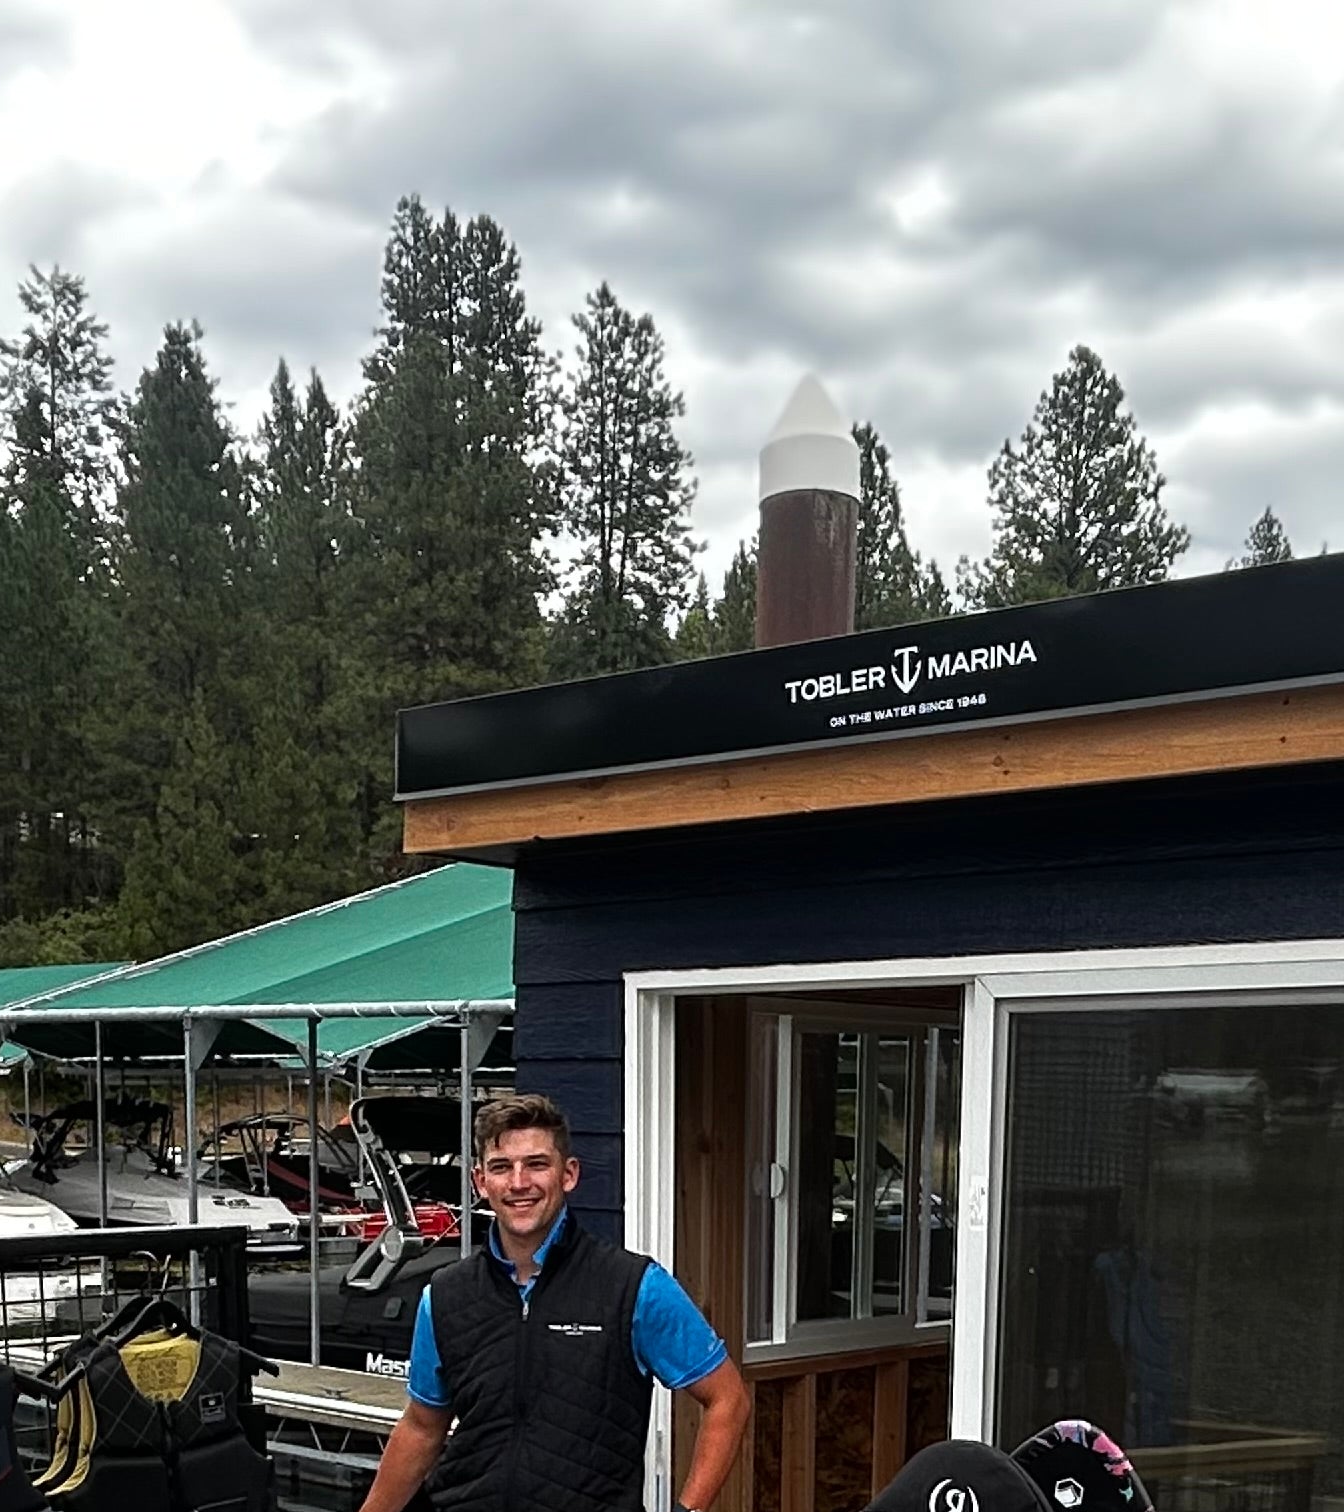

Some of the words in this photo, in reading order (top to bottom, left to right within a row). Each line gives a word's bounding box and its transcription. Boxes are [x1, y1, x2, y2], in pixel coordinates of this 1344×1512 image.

[785, 666, 886, 704] TOBLER
[928, 640, 1037, 680] MARINA
[829, 717, 846, 728] ON
[849, 711, 872, 726] THE
[873, 704, 916, 721] WATER
[918, 699, 954, 714] SINCE
